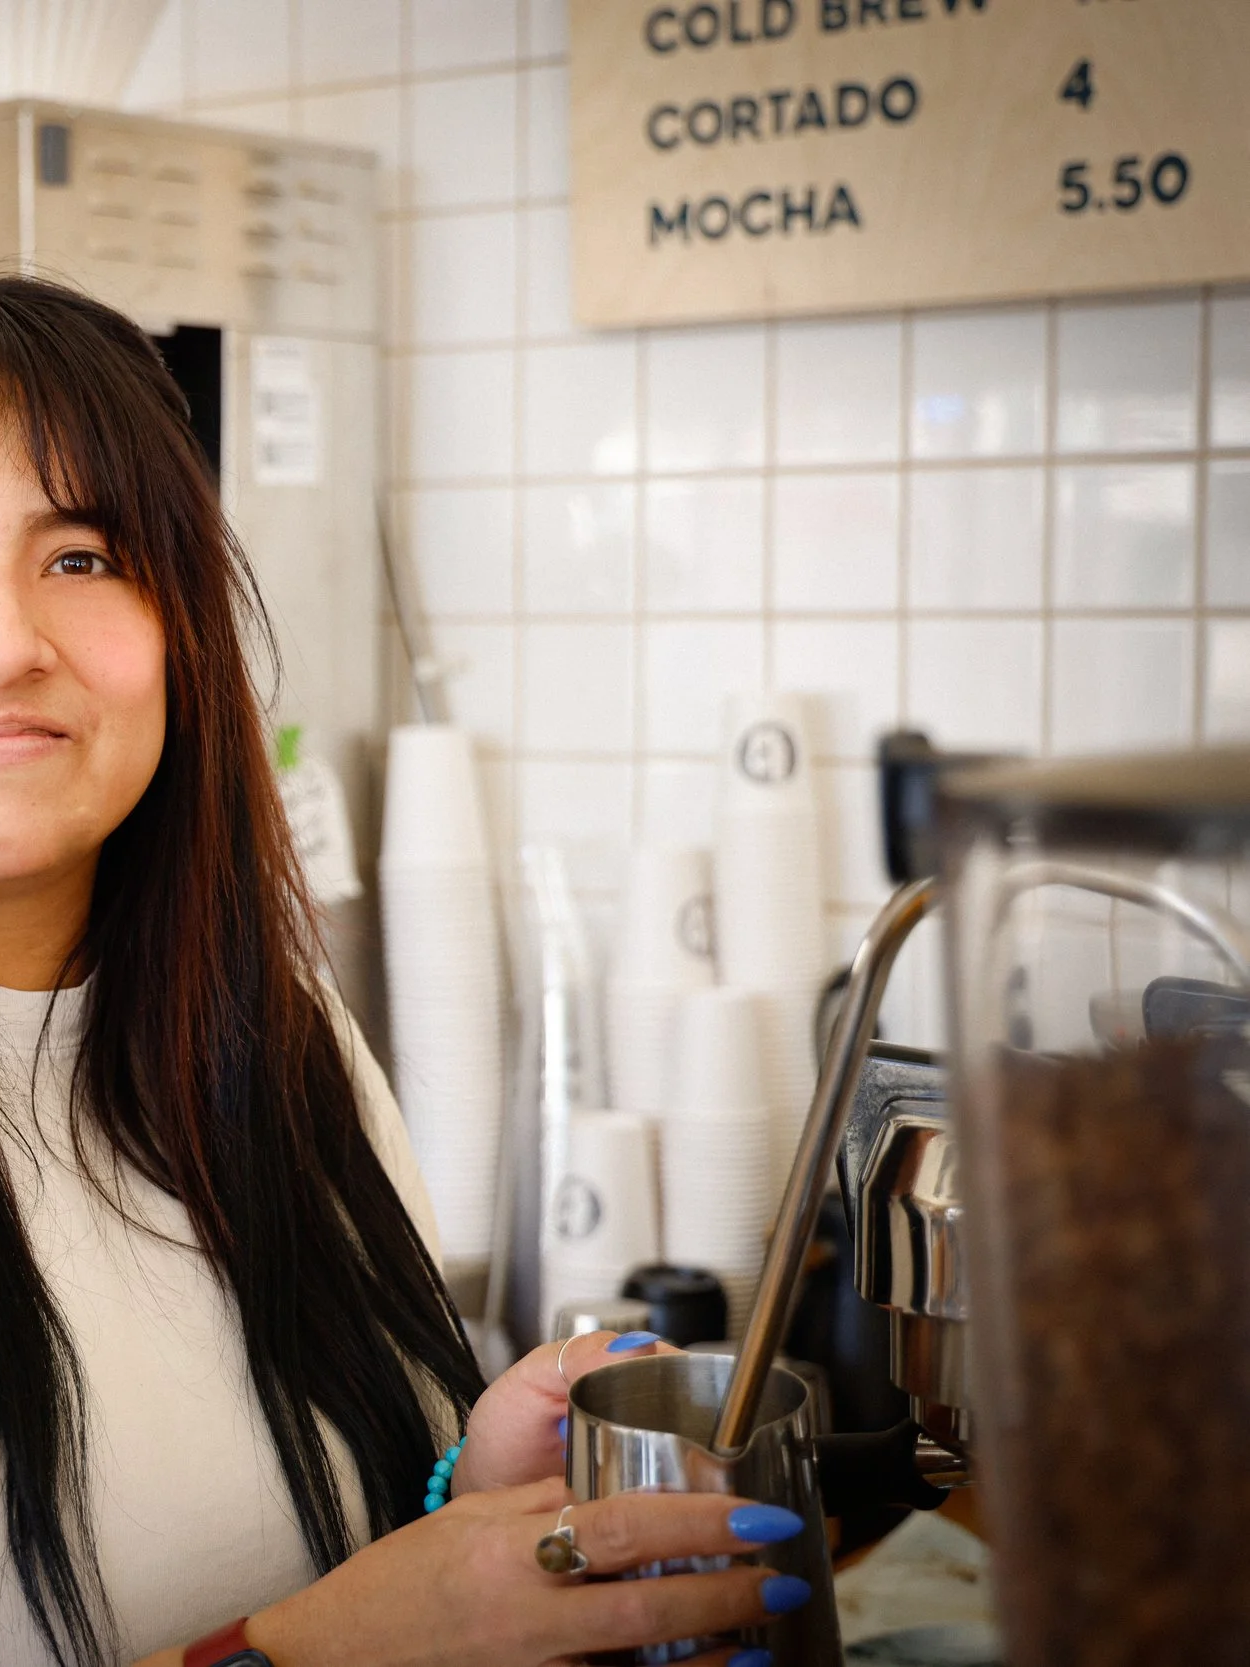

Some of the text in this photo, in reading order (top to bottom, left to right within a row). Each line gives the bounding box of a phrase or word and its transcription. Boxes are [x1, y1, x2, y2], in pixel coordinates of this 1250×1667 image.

[645, 0, 988, 53] COLD BR
[646, 58, 1095, 151] CORTADO 4
[648, 152, 1190, 246] MOCHA 5.50
